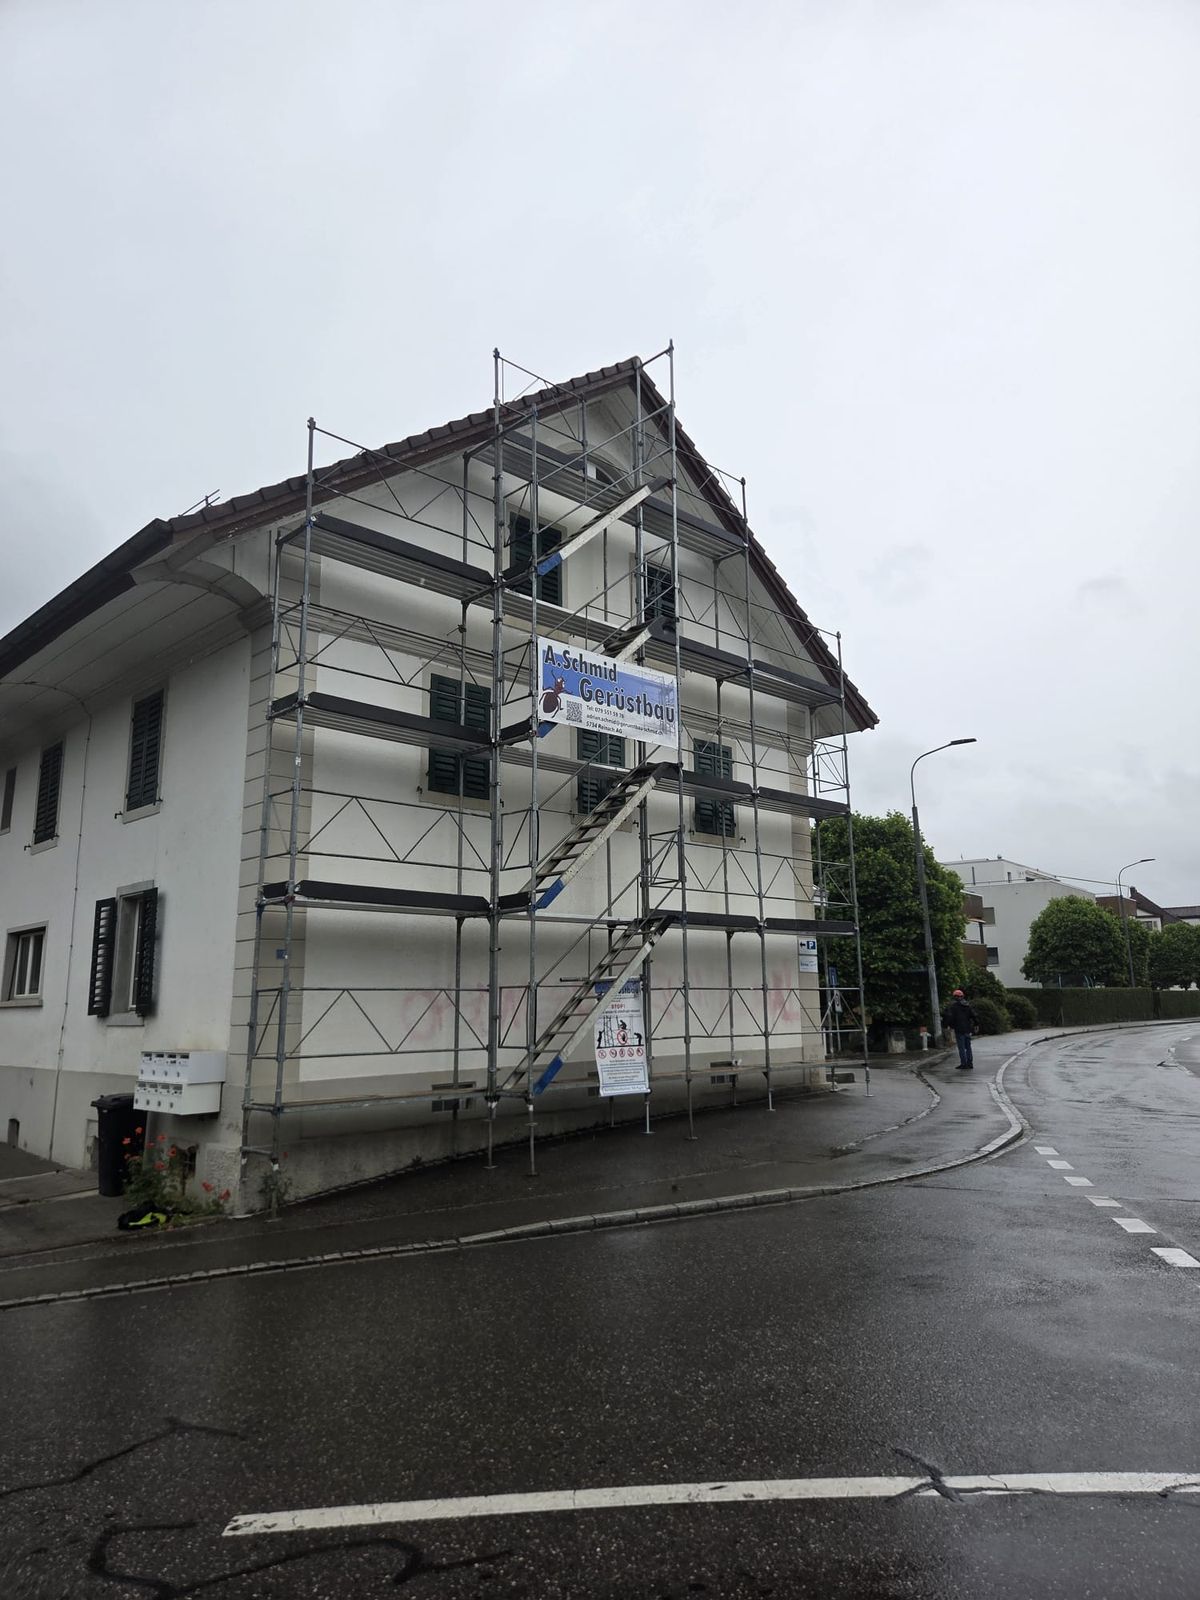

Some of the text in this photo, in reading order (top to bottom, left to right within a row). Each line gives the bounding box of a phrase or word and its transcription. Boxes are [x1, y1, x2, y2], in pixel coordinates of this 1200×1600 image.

[544, 645, 617, 682] A.Schmid
[579, 678, 675, 723] Gerüstbau
[586, 721, 598, 729] 5734
